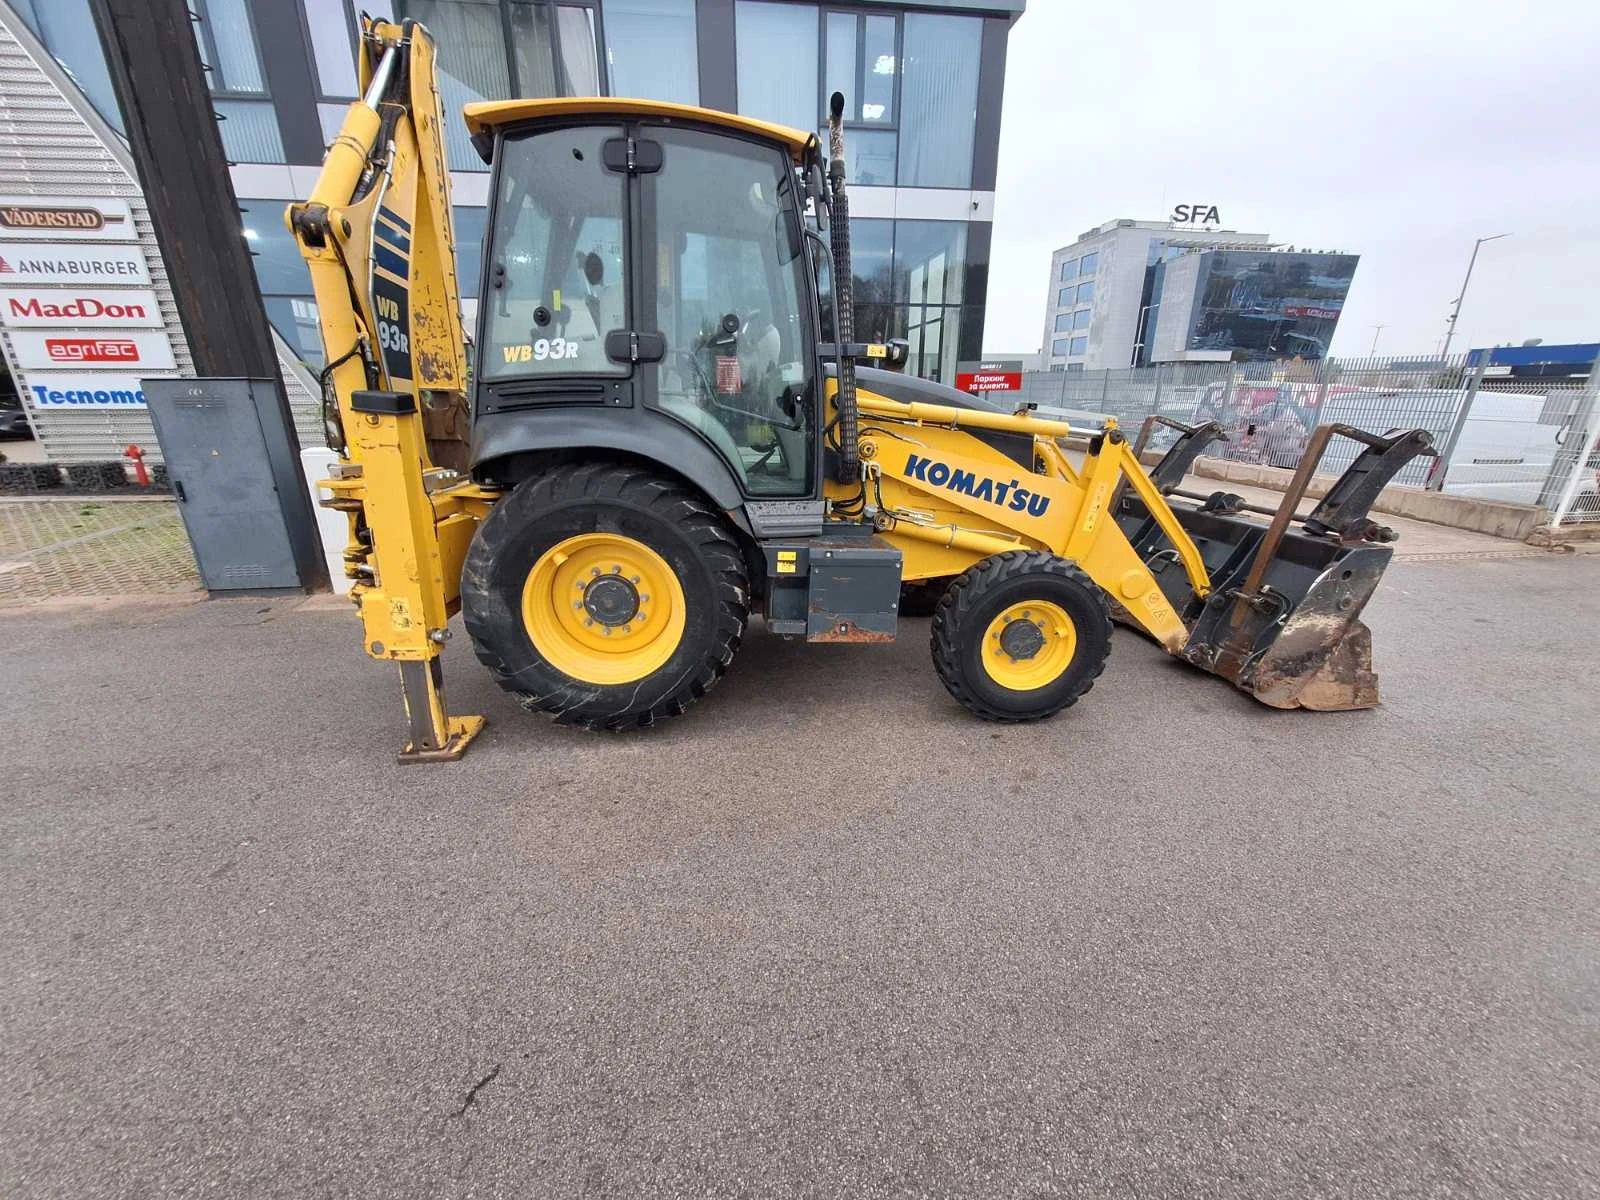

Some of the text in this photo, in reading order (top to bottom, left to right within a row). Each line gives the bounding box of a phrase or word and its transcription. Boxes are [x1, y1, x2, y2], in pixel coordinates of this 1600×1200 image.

[2, 208, 98, 227] VÄDERSTAD
[1173, 204, 1221, 225] SFA
[19, 260, 139, 275] ANNABURGER
[8, 298, 146, 318] MacDon
[376, 295, 399, 322] WB
[379, 321, 409, 354] 93R
[50, 343, 135, 359] agrifac
[903, 454, 1050, 517] KOMATSU
